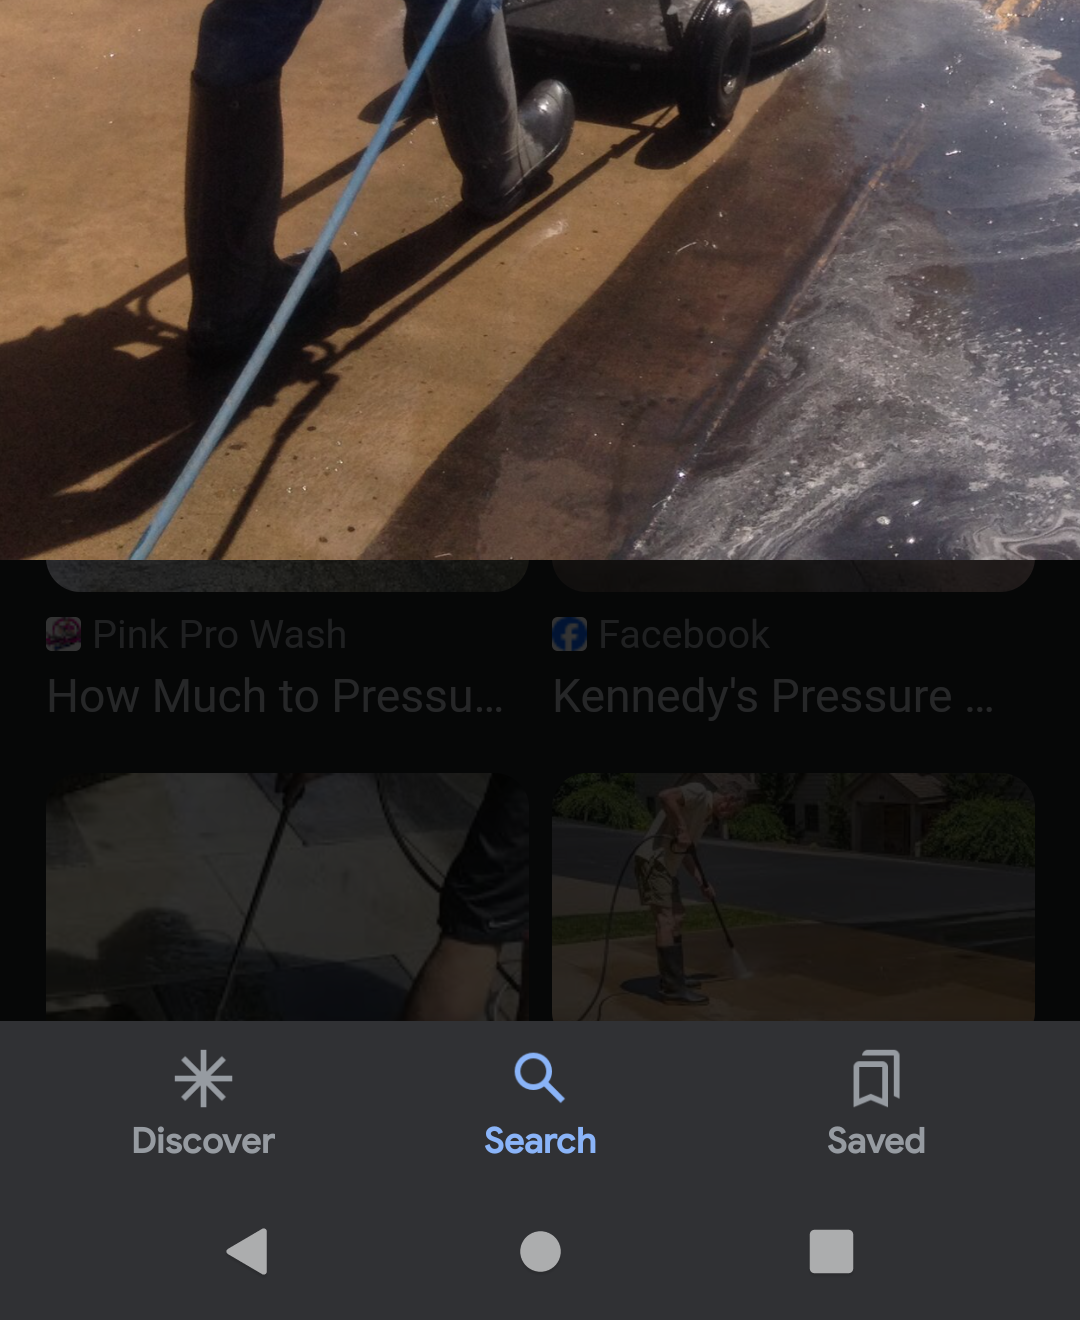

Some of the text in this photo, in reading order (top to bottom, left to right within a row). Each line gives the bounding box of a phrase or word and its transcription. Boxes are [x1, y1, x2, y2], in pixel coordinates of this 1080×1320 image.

[94, 617, 169, 649] Pink
[181, 619, 239, 649] Pro
[249, 617, 346, 649] Wash
[600, 617, 771, 649] Facebook
[49, 678, 140, 713] How
[154, 676, 265, 713] Much
[278, 680, 319, 713] to
[555, 676, 758, 722] Kennedy's
[773, 678, 952, 713] Pressure
[133, 1125, 276, 1155] Discover
[484, 1125, 597, 1155] Search
[827, 1125, 926, 1155] Saved
